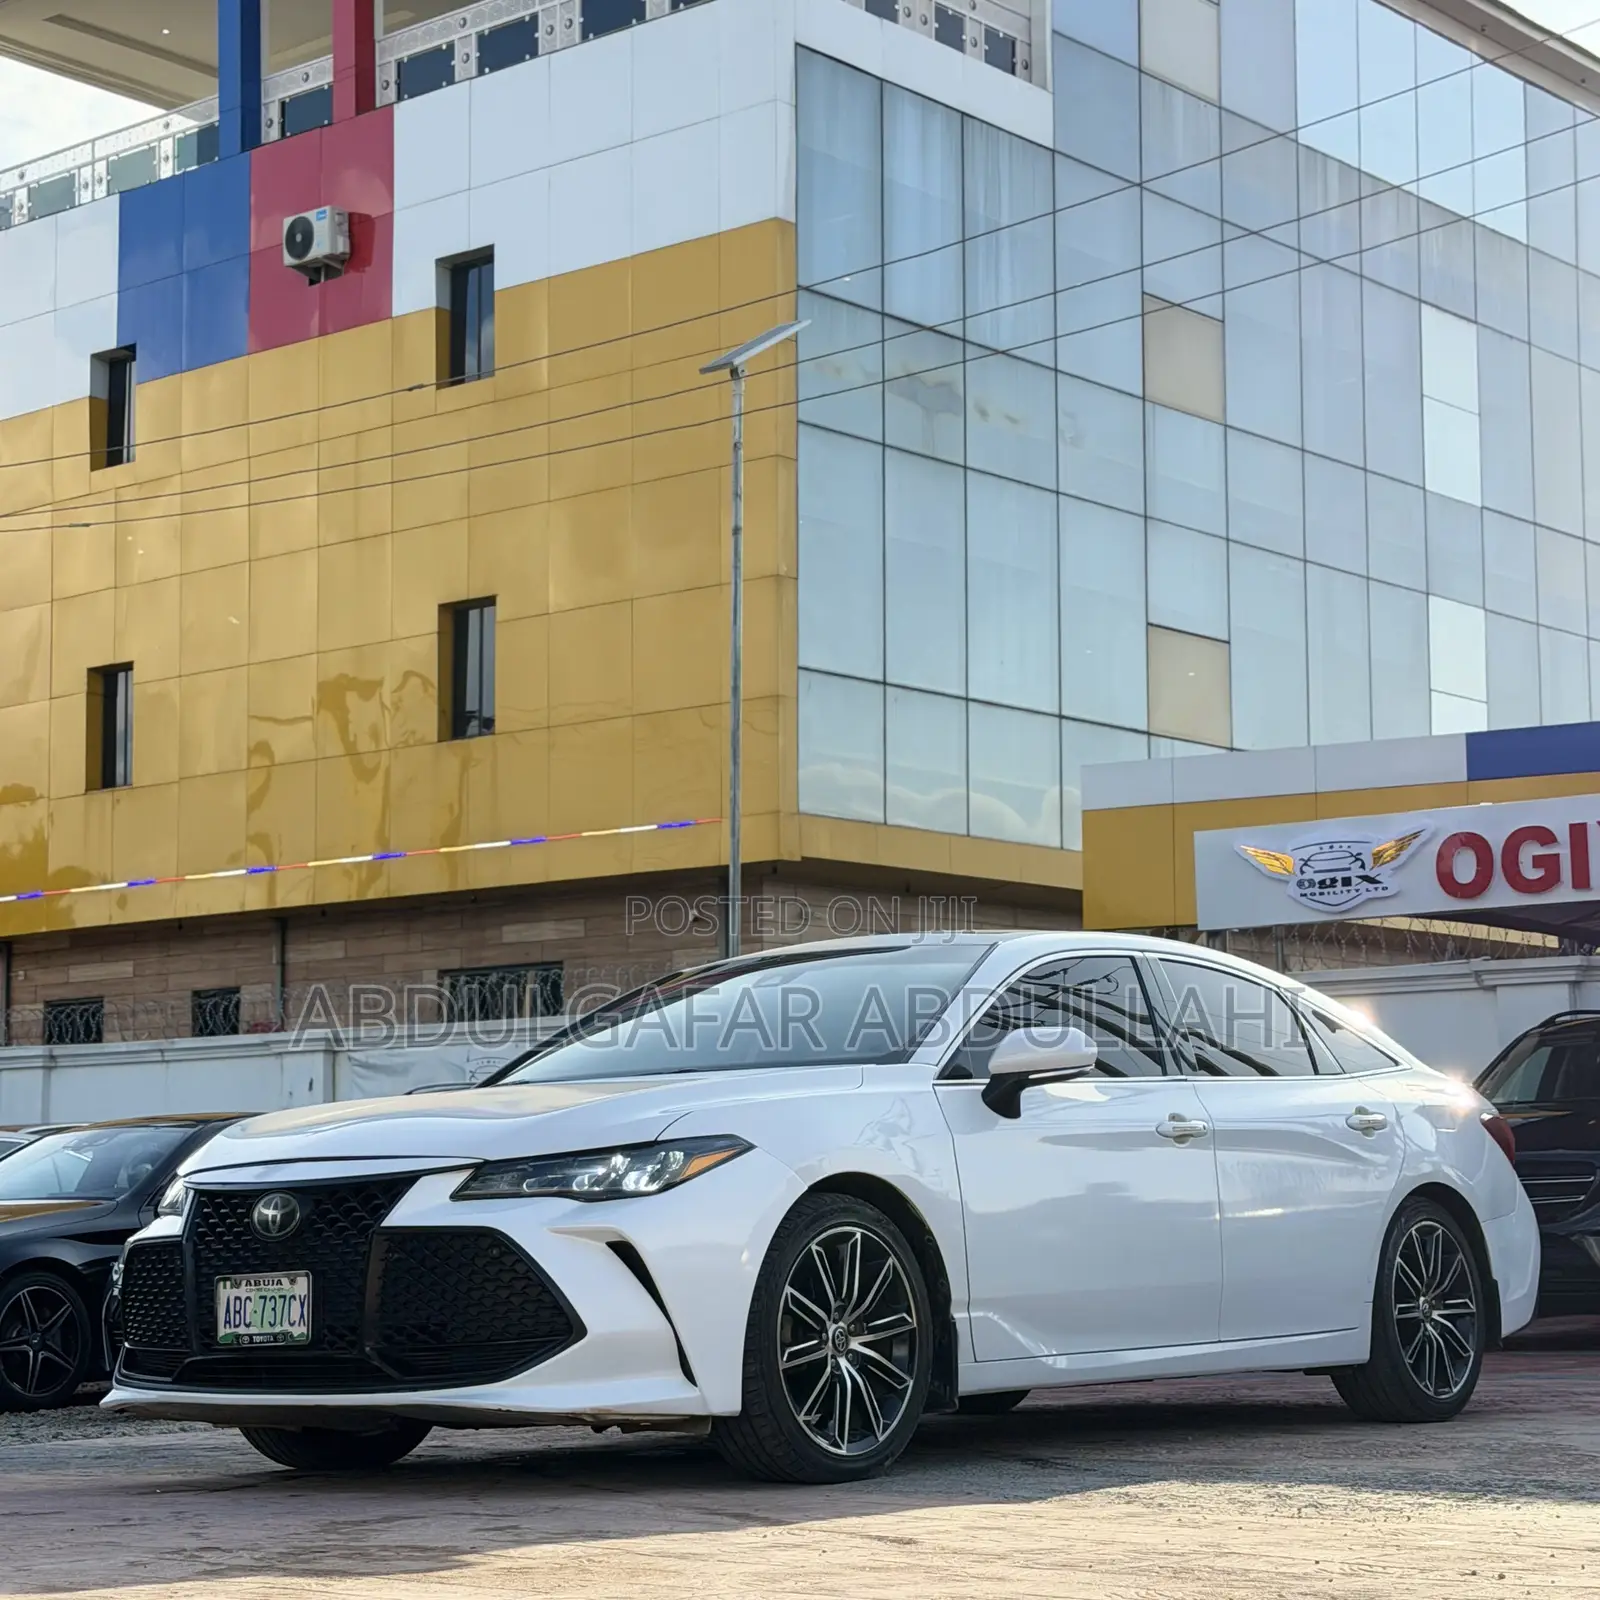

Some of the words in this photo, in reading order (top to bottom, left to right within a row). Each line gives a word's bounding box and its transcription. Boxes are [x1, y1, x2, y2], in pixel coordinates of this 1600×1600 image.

[1436, 821, 1600, 899] OGI
[1300, 888, 1361, 897] MOBILITY
[245, 1278, 284, 1288] ABUJA
[252, 1335, 274, 1343] TOYOTA
